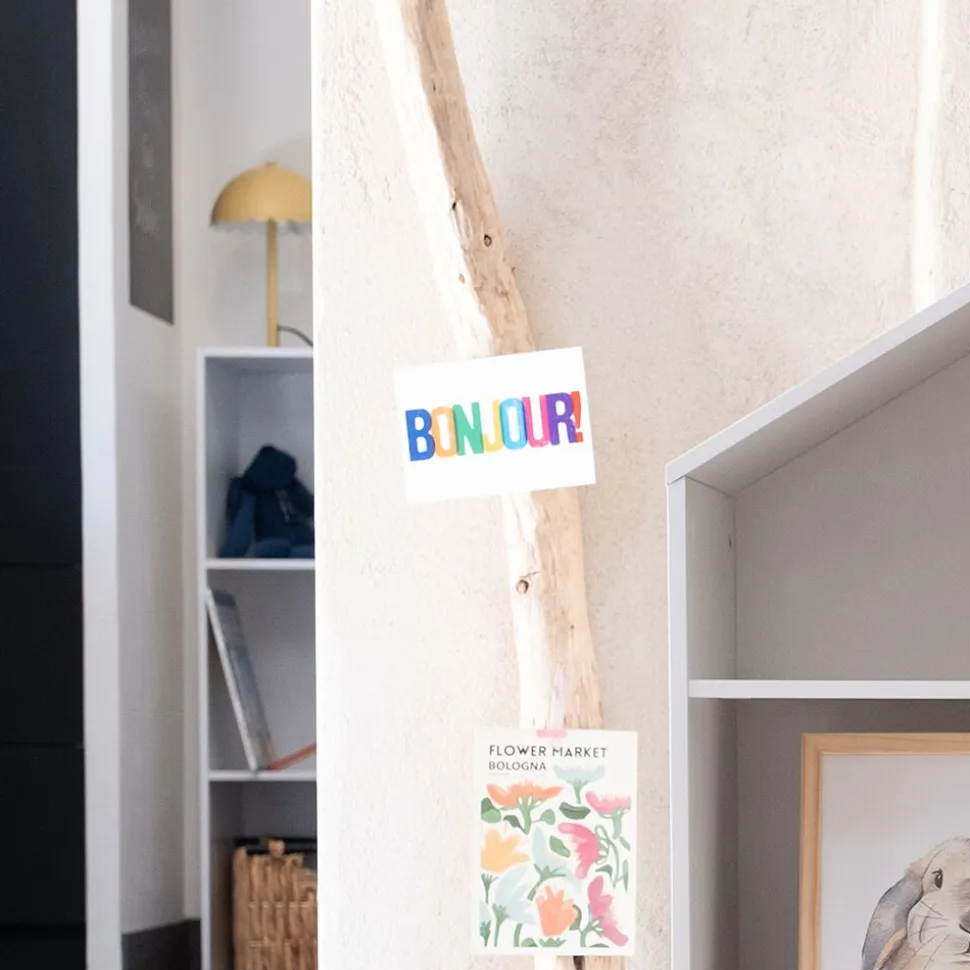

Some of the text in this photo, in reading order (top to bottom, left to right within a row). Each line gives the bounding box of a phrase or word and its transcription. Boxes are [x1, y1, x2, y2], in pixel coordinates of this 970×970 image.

[405, 391, 584, 461] BONJOUR!
[489, 744, 608, 758] FLOWER MARKET
[488, 761, 547, 771] BOLOGNA
